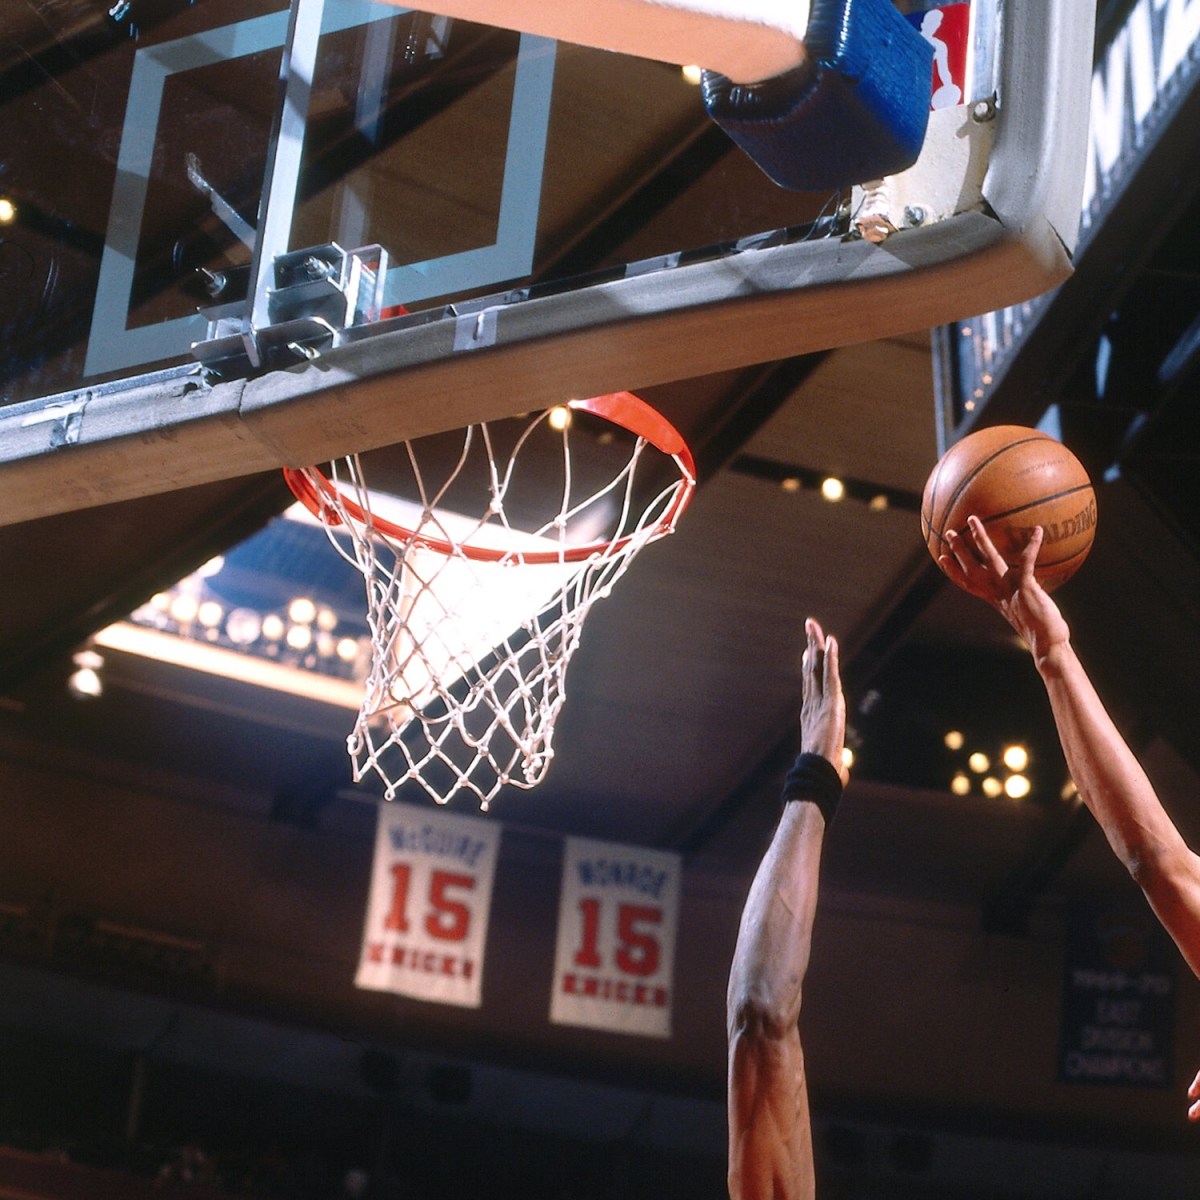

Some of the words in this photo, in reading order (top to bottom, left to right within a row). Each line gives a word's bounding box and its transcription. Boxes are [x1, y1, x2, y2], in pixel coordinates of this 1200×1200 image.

[577, 858, 669, 898] MONROE
[384, 862, 476, 942] 15
[574, 897, 663, 977] 15
[368, 943, 475, 980] KNICKS
[562, 973, 669, 1009] KNICKS
